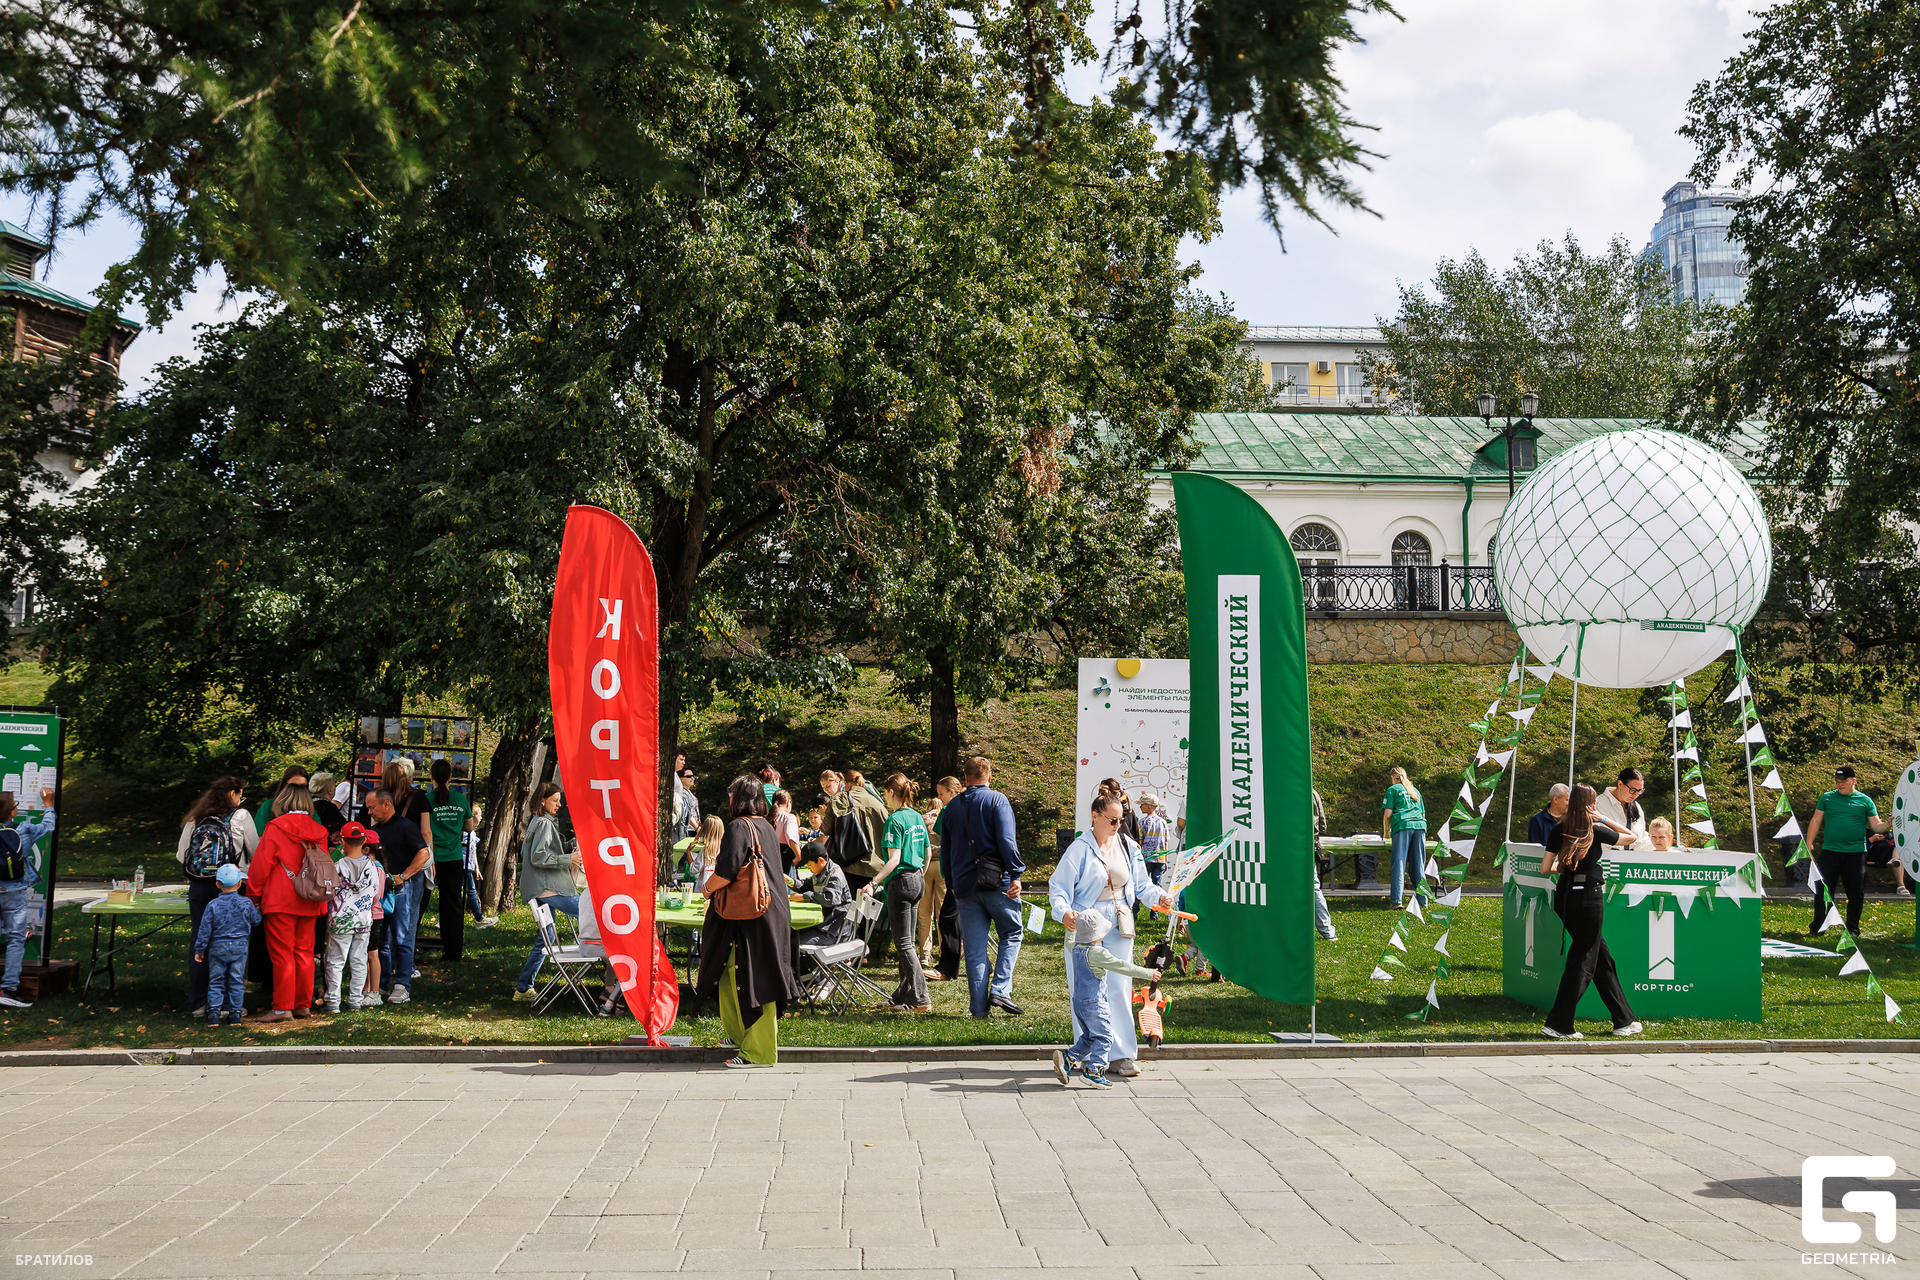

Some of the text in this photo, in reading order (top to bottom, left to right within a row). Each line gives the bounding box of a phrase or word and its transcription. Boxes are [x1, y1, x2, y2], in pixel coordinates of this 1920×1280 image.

[1656, 623, 1703, 631] АКАДЕМИЧЕСКИЙ
[1224, 594, 1253, 830] АКАДЕМИЧЕСКИЙ
[1625, 868, 1729, 881] АКАДЕМИЧЕСКИЙ
